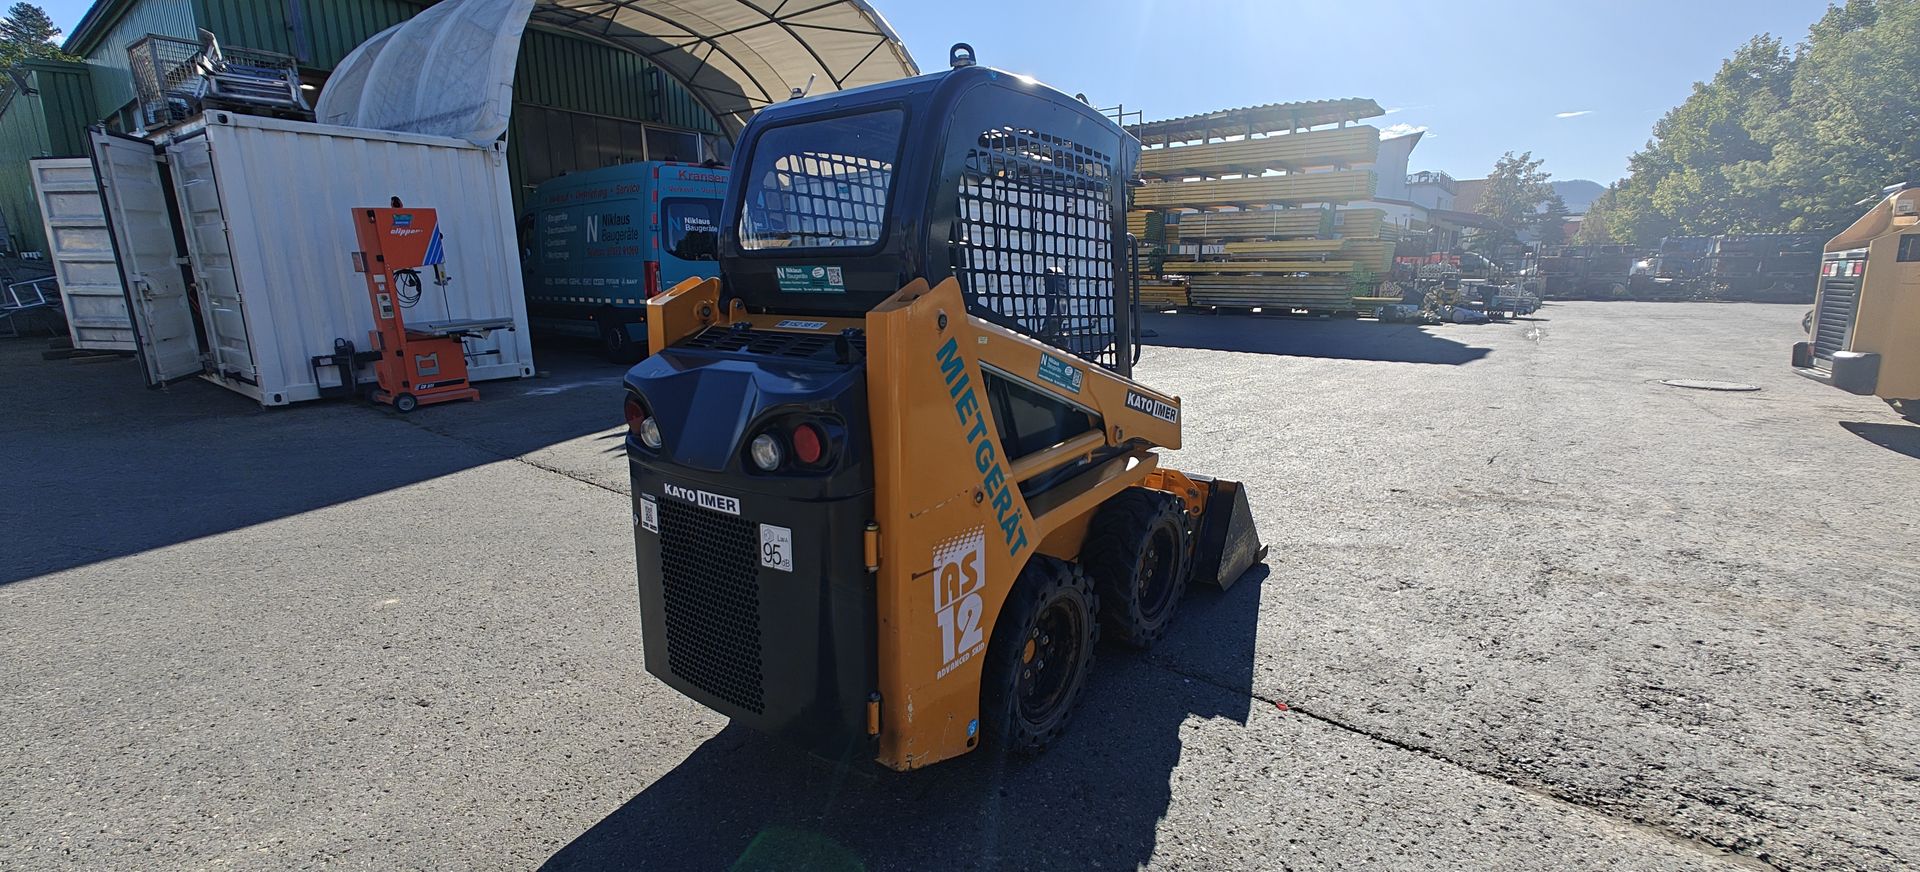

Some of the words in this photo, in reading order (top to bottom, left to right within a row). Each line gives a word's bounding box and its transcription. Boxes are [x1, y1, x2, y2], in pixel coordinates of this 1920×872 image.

[602, 212, 631, 226] Niklaus
[684, 217, 711, 225] Niklaus
[685, 224, 718, 233] Baugeräte
[601, 228, 639, 244] Baugeräte
[776, 267, 785, 279] N
[1127, 392, 1153, 412] KATO
[1154, 402, 1177, 422] IMER
[937, 336, 1028, 557] MIETGERÄT
[664, 483, 696, 502] KATO
[699, 492, 737, 512] IMER
[763, 542, 782, 565] 95
[940, 550, 977, 609] AS
[937, 592, 983, 665] 12
[936, 652, 971, 681] ADVANCED
[971, 642, 985, 657] SKID
